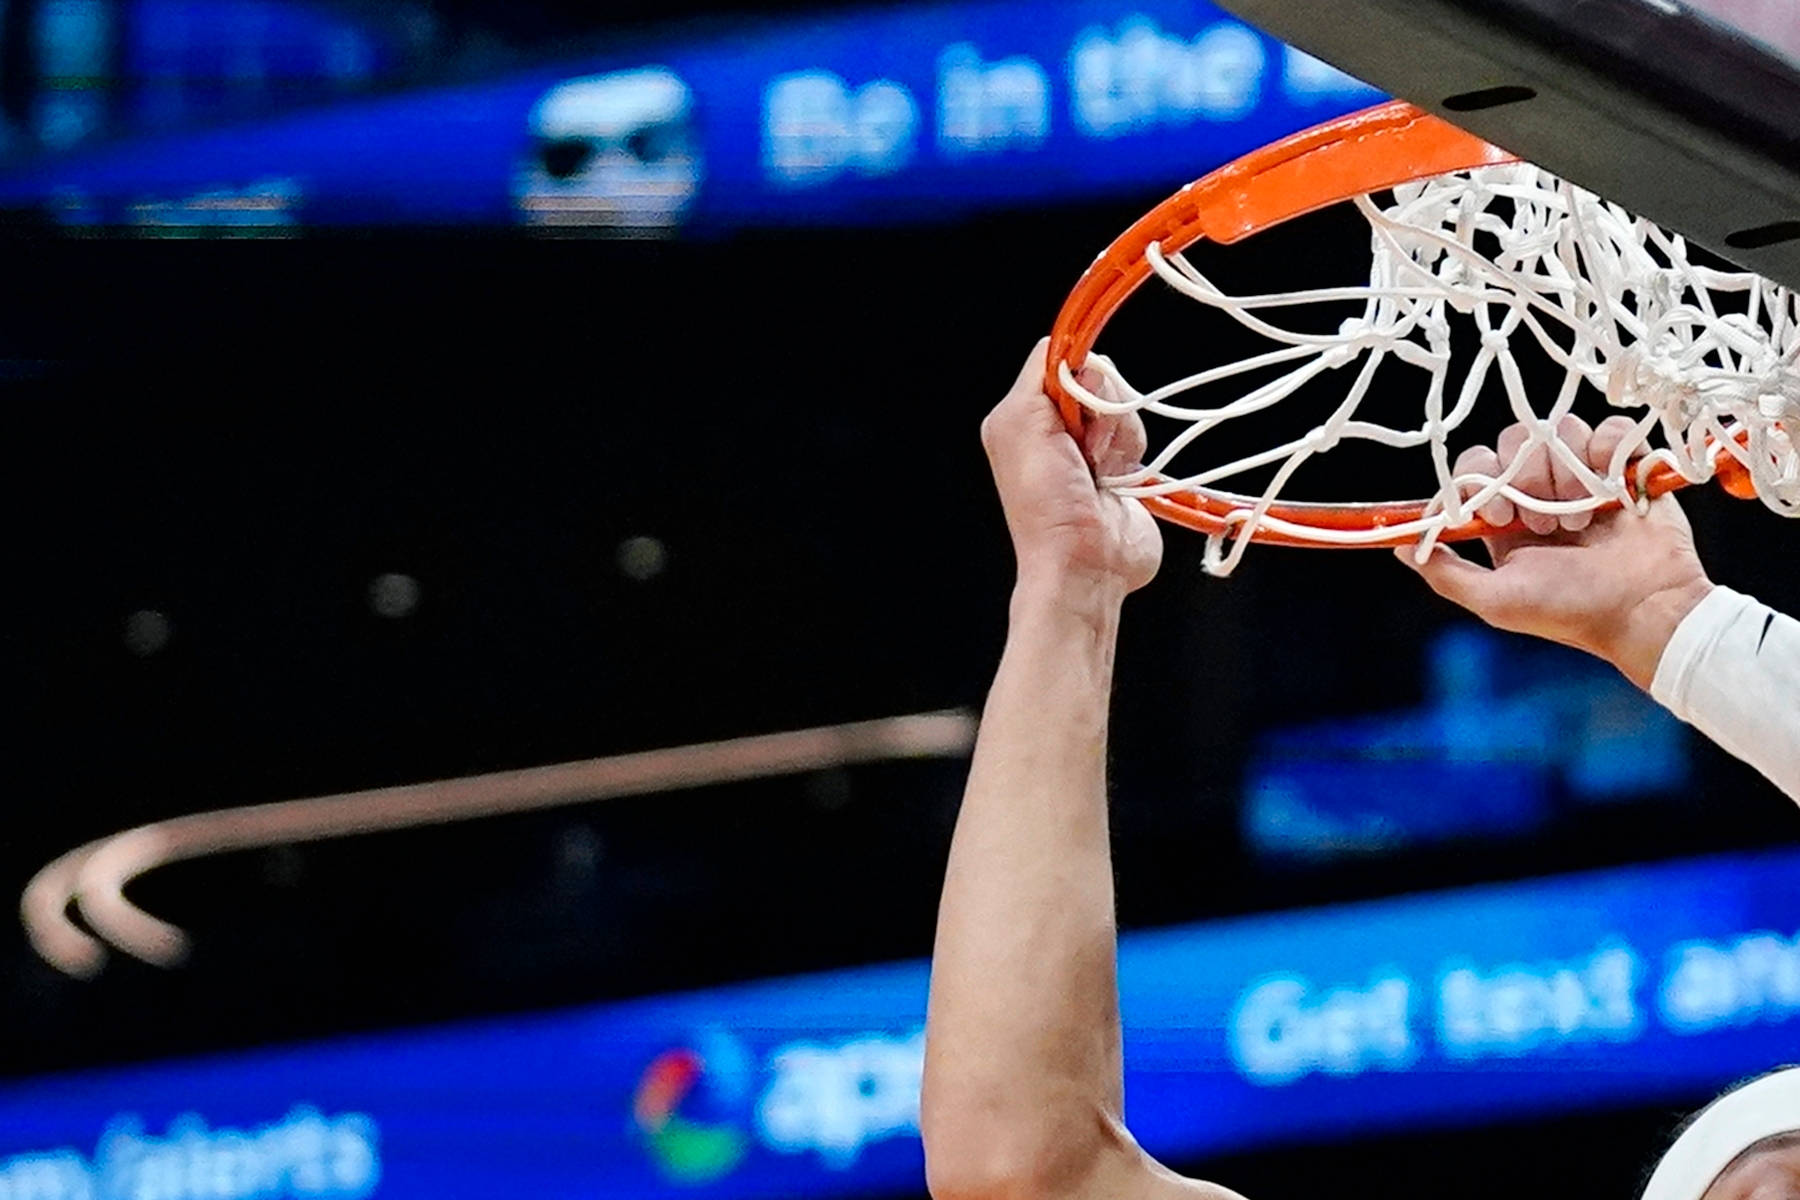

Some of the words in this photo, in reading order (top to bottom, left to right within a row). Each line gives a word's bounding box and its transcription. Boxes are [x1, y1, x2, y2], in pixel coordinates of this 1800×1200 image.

[764, 72, 912, 180] Be
[940, 46, 1050, 150] in
[1072, 16, 1262, 136] the
[1234, 972, 1414, 1080] Get
[1438, 942, 1638, 1054] text
